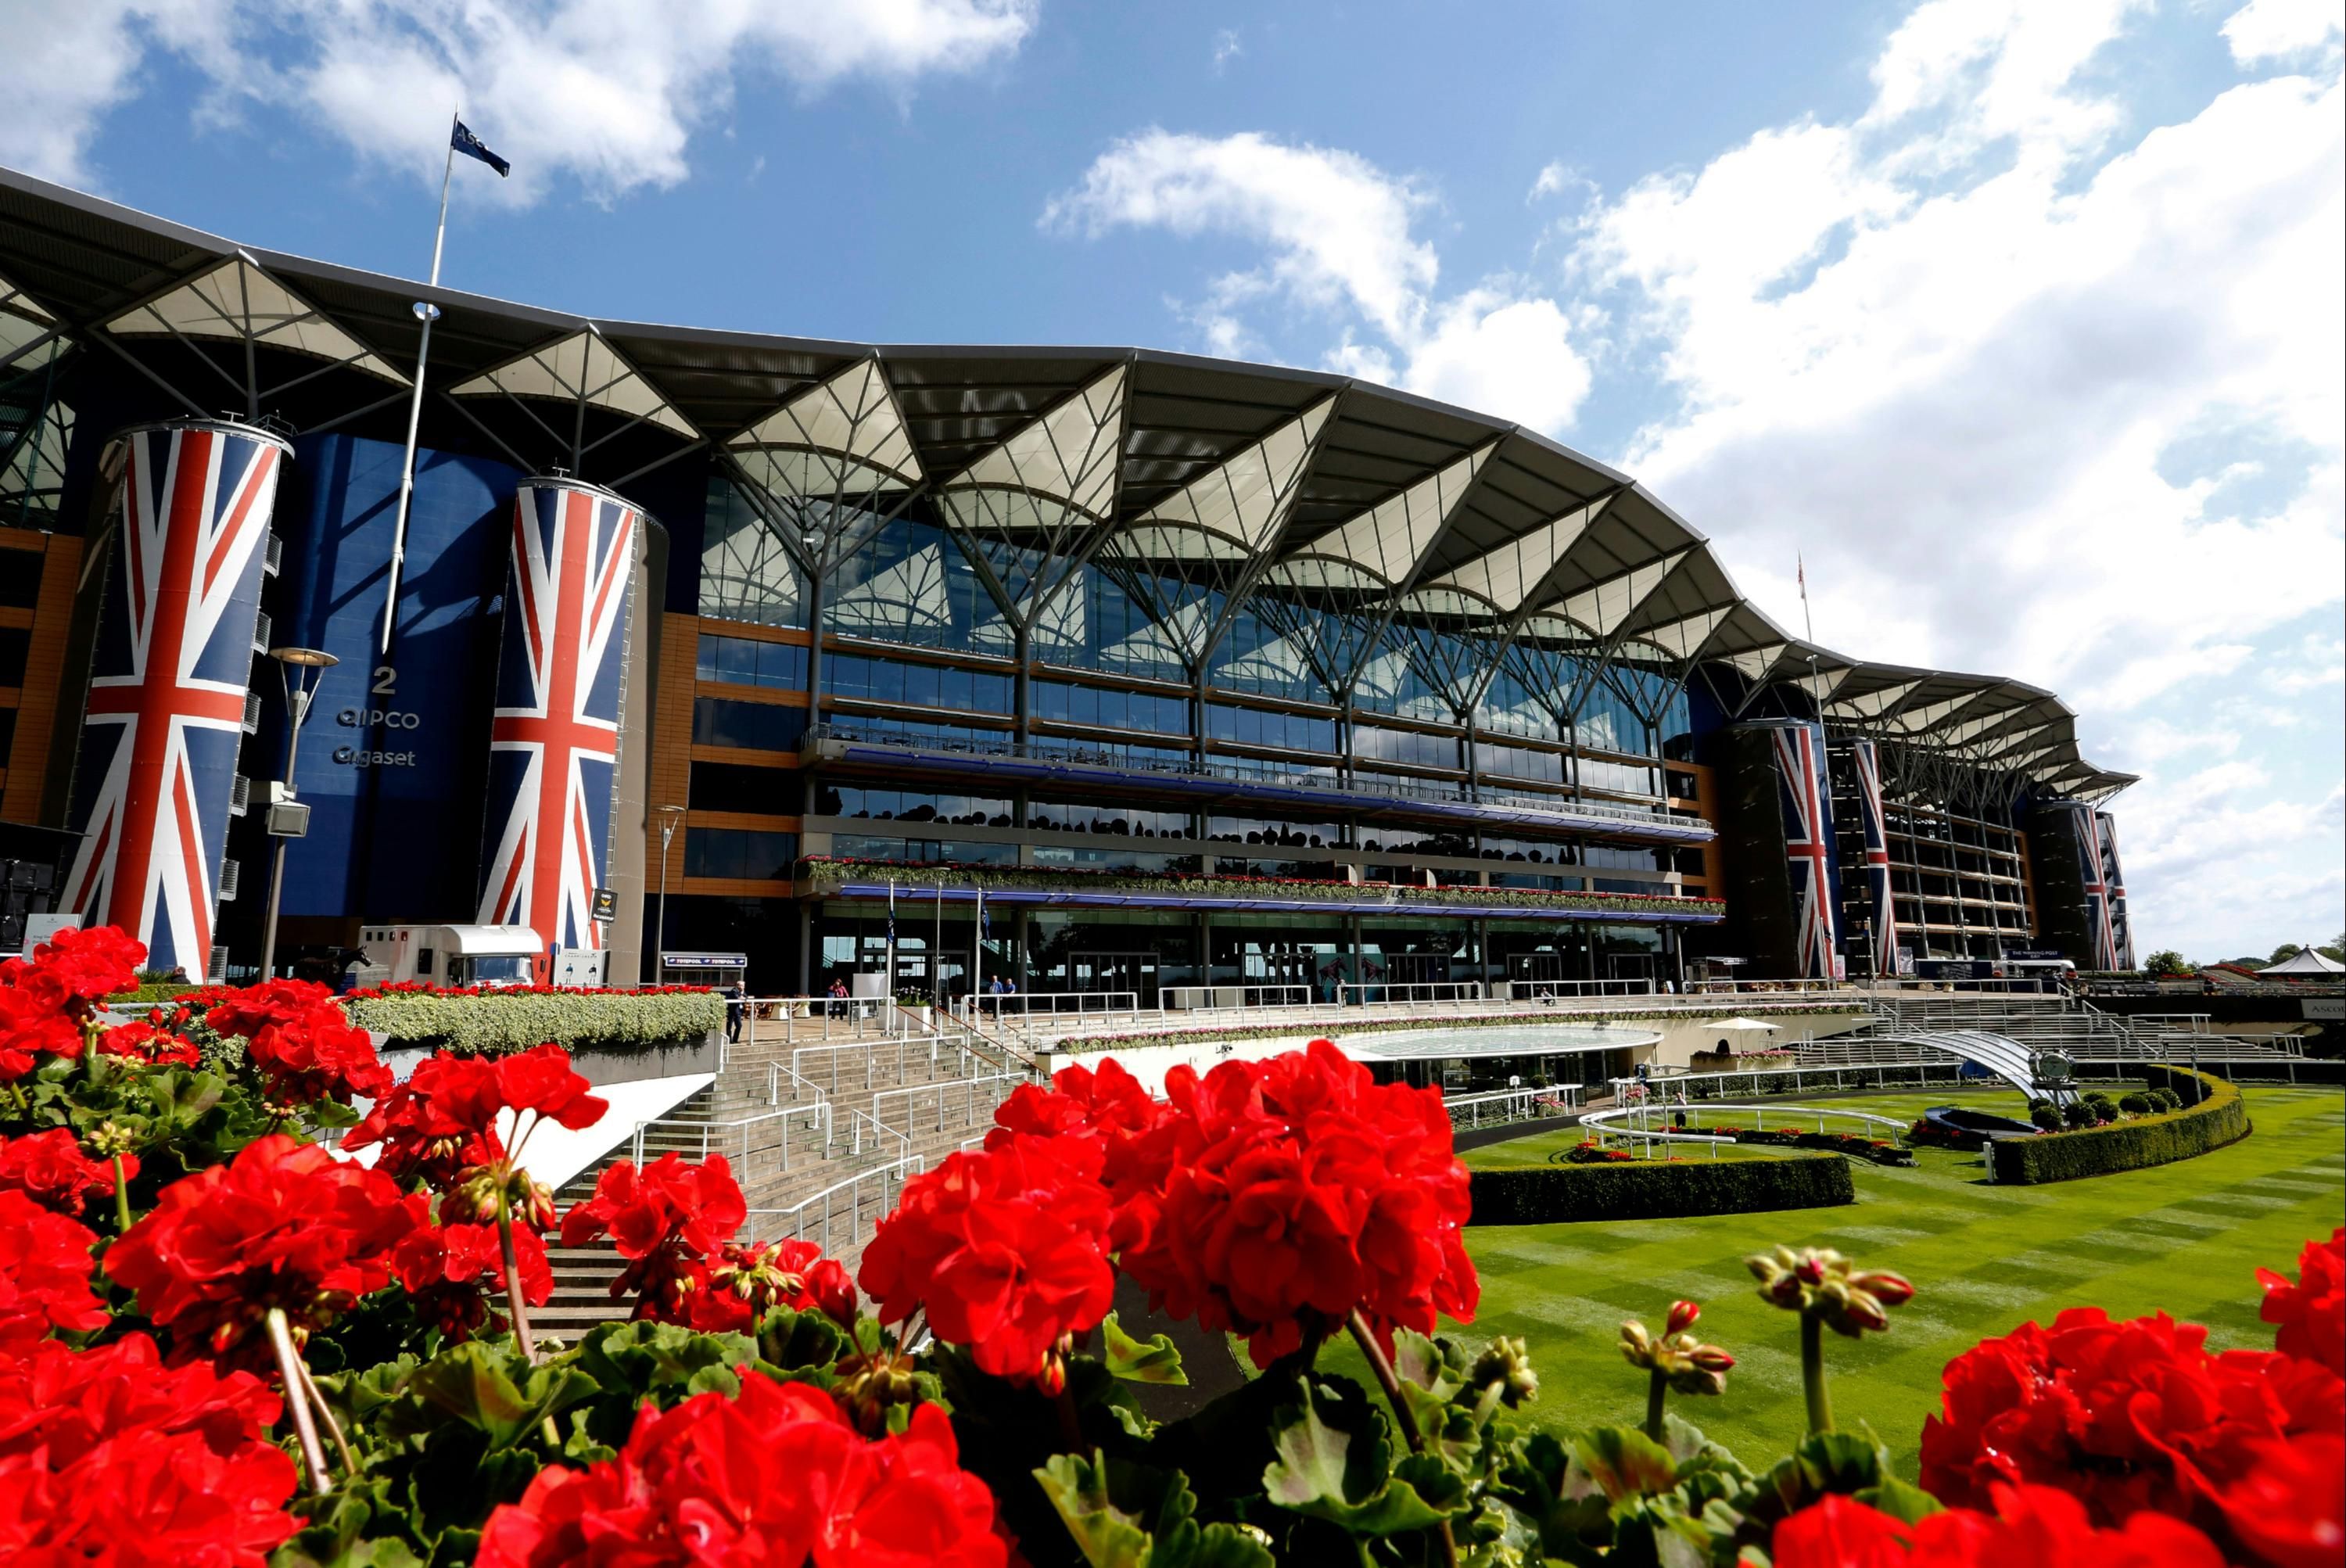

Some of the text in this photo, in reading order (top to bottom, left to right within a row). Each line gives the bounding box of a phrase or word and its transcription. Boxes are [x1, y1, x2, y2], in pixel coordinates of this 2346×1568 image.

[371, 666, 397, 694] 2
[339, 707, 420, 729] QIPCO
[335, 745, 416, 767] Gigaset
